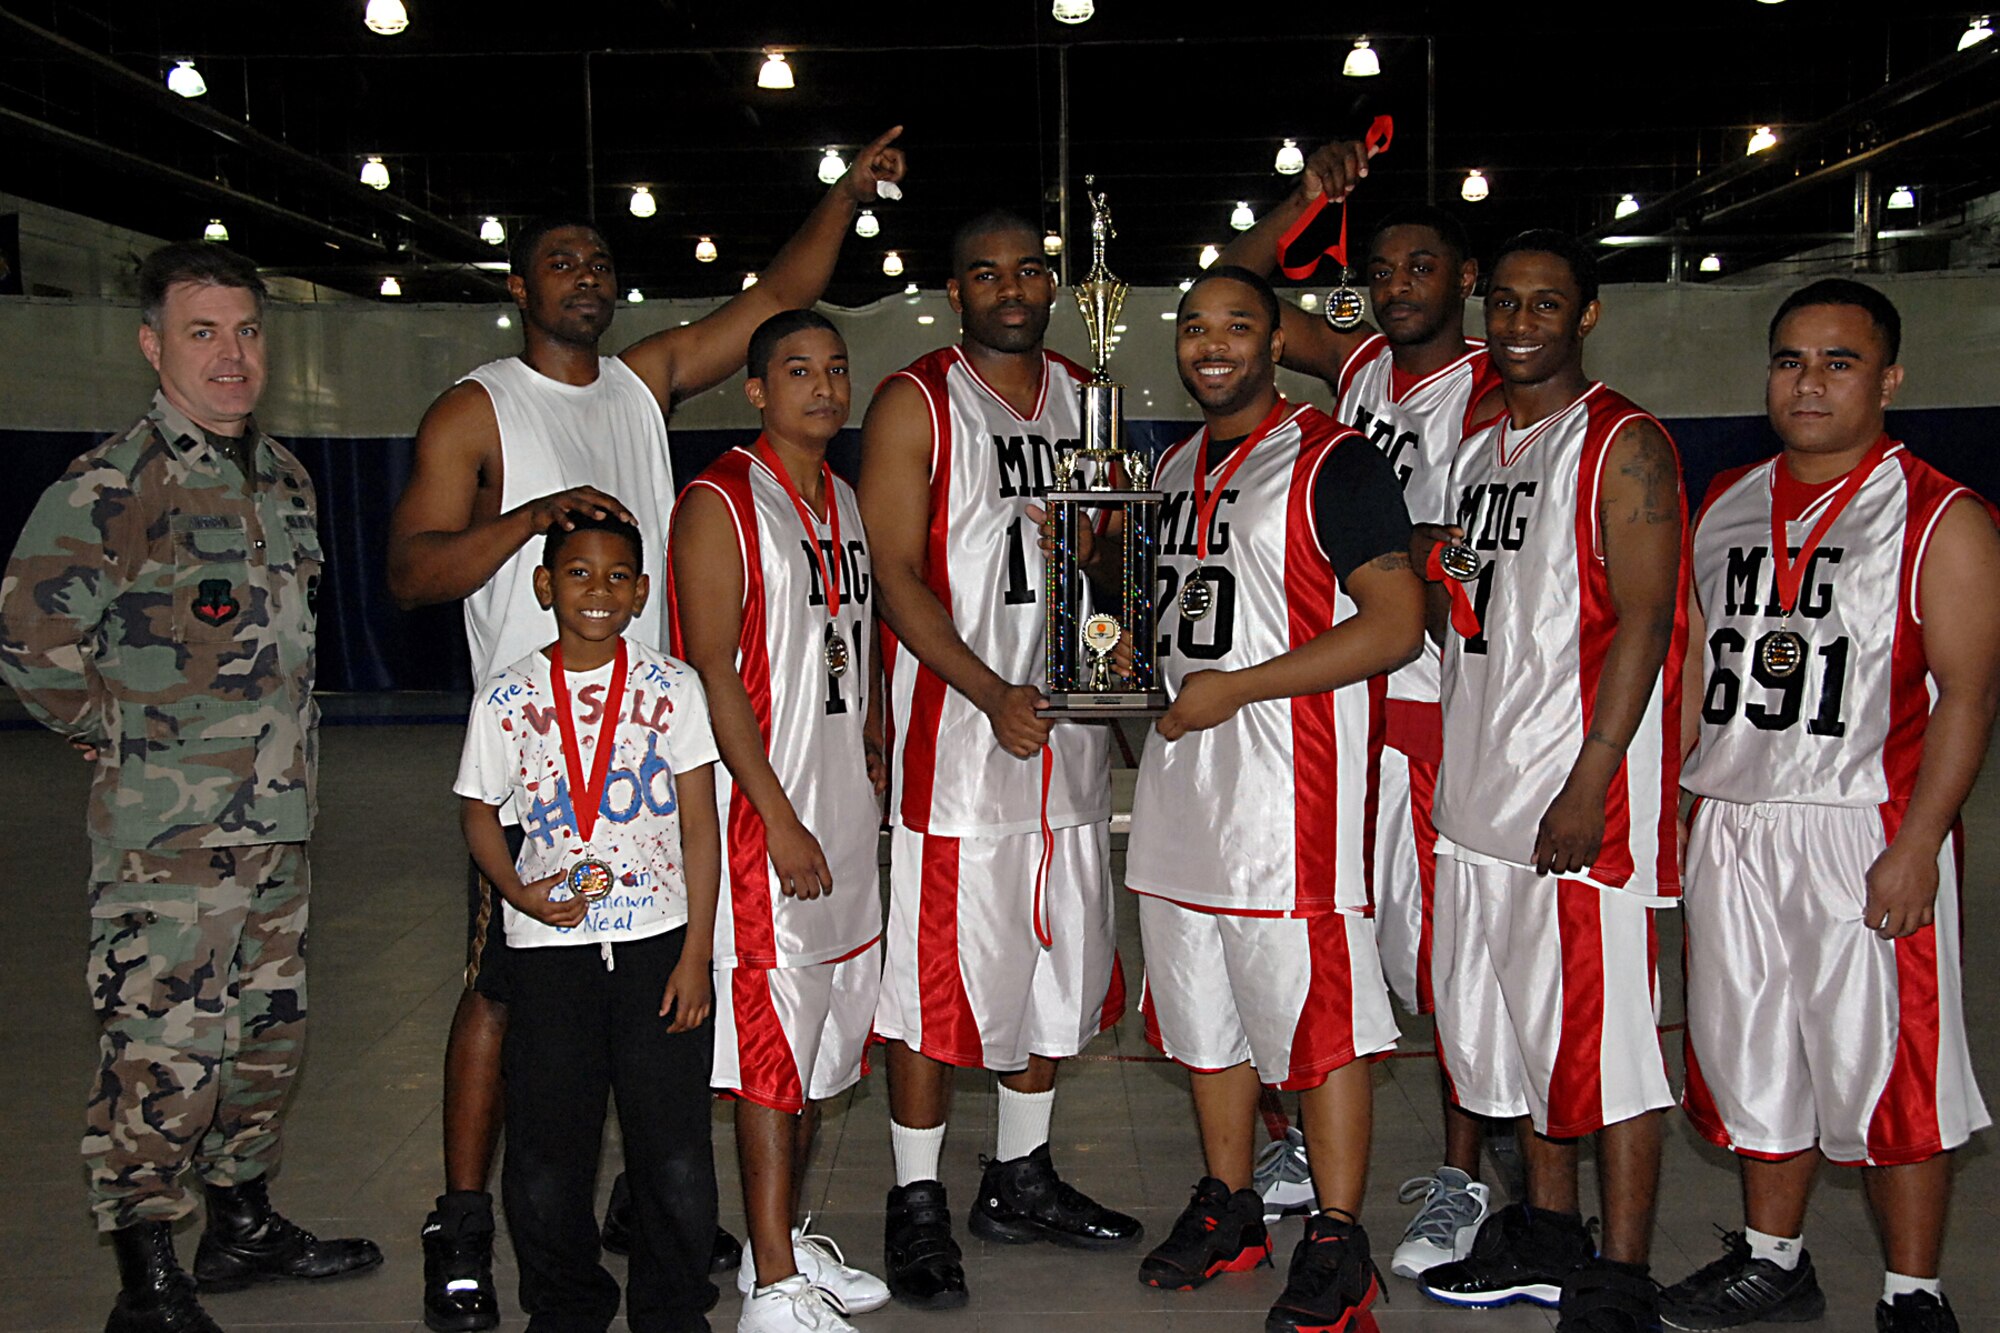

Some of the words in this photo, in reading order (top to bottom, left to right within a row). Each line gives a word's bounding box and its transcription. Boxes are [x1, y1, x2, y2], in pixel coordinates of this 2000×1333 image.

[993, 434, 1087, 498] MDG
[1457, 481, 1538, 551] MDG
[1157, 565, 1235, 660] 20
[488, 683, 522, 706] Tre
[646, 664, 671, 690] Tre
[1702, 627, 1849, 737] 691
